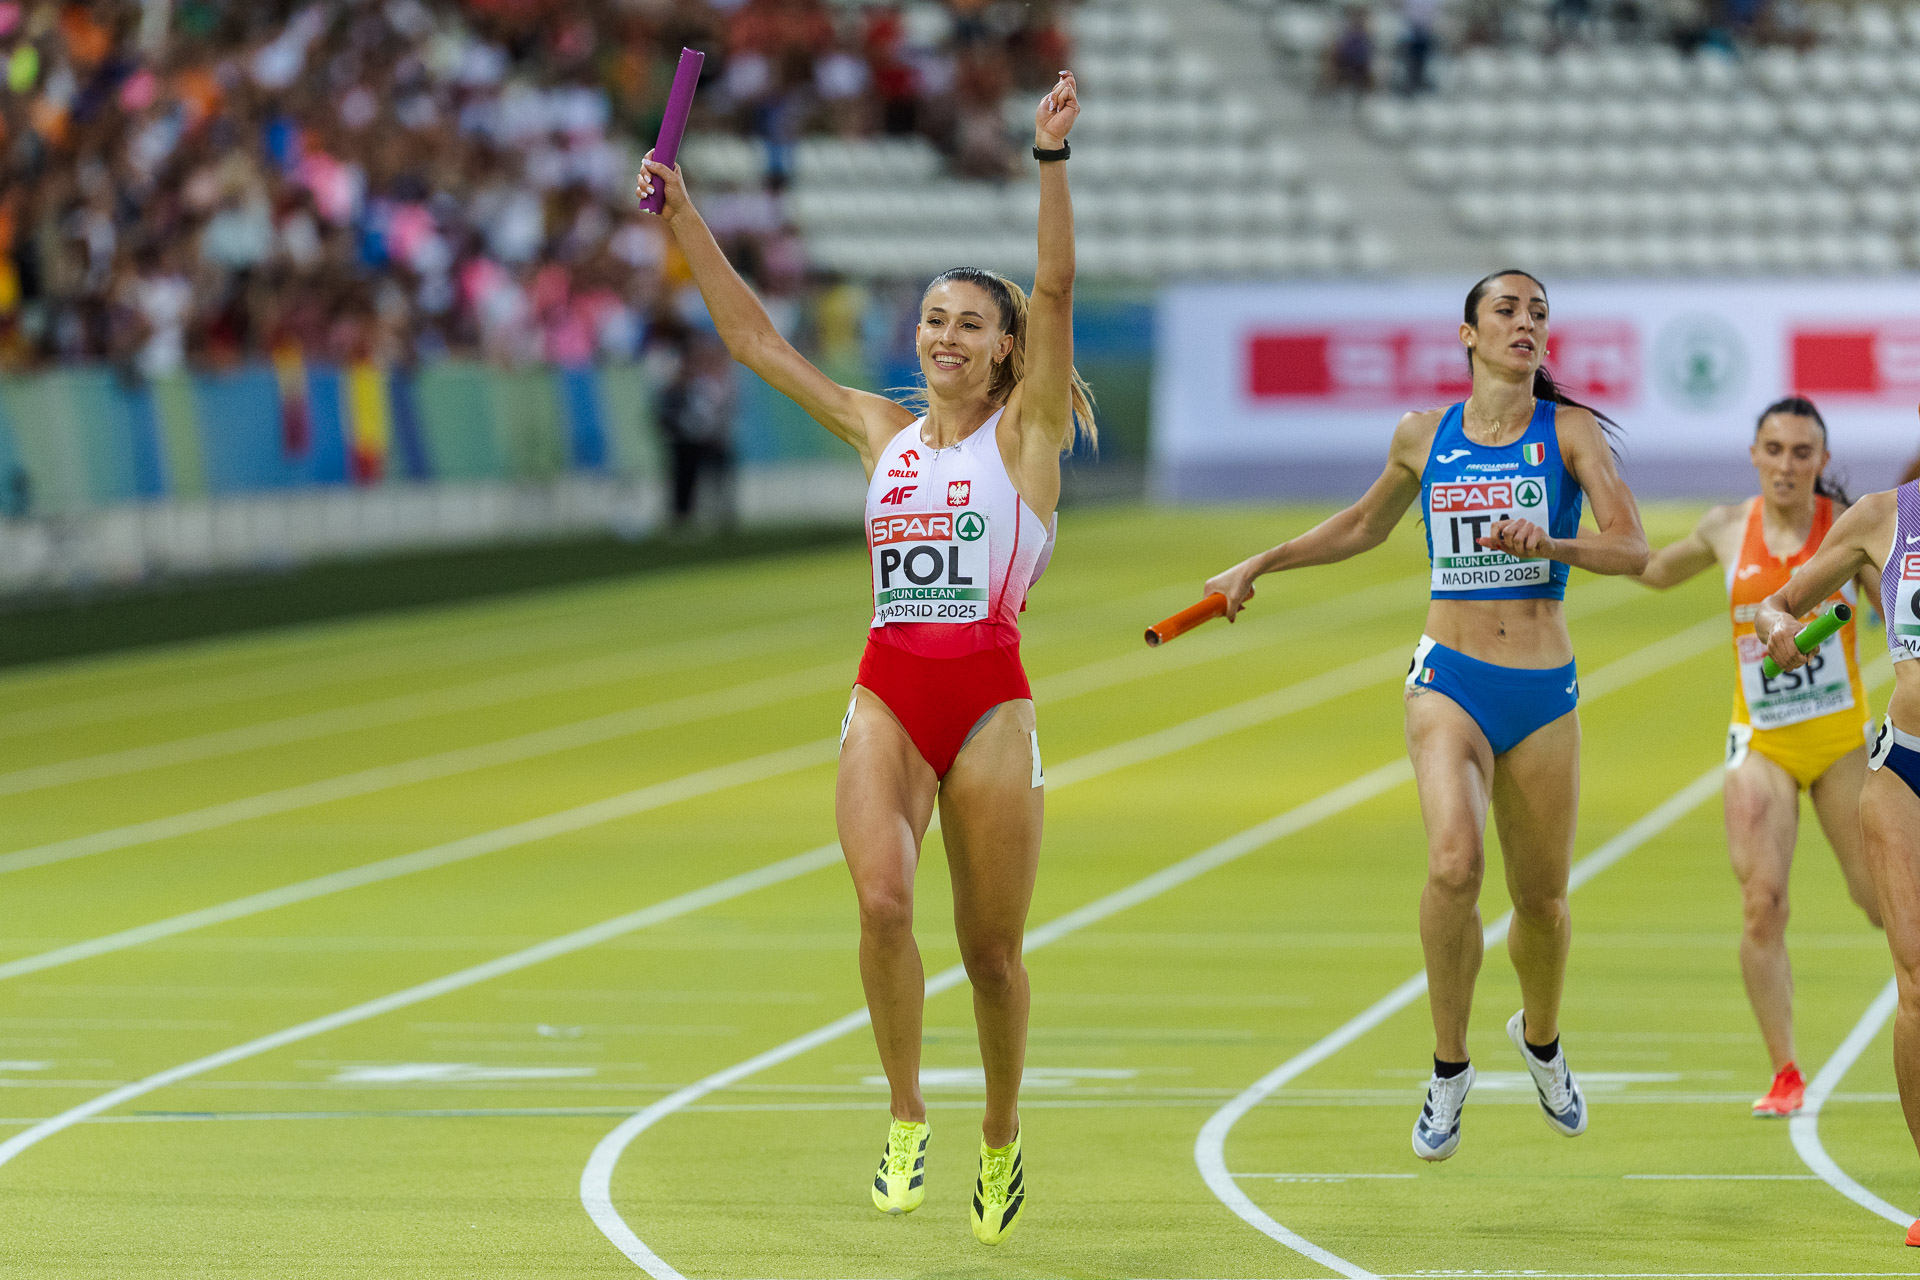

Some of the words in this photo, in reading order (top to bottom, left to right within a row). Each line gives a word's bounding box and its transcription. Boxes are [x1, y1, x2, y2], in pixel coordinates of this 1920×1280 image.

[888, 469, 918, 478] ORLEN
[880, 485, 918, 505] 4F
[1432, 485, 1510, 509] SPAR
[873, 517, 950, 543] SPAR
[880, 545, 973, 589] POL
[1456, 556, 1481, 567] RUN
[1442, 570, 1500, 585] MADRID
[1504, 566, 1540, 582] 2025
[937, 604, 977, 618] 2025
